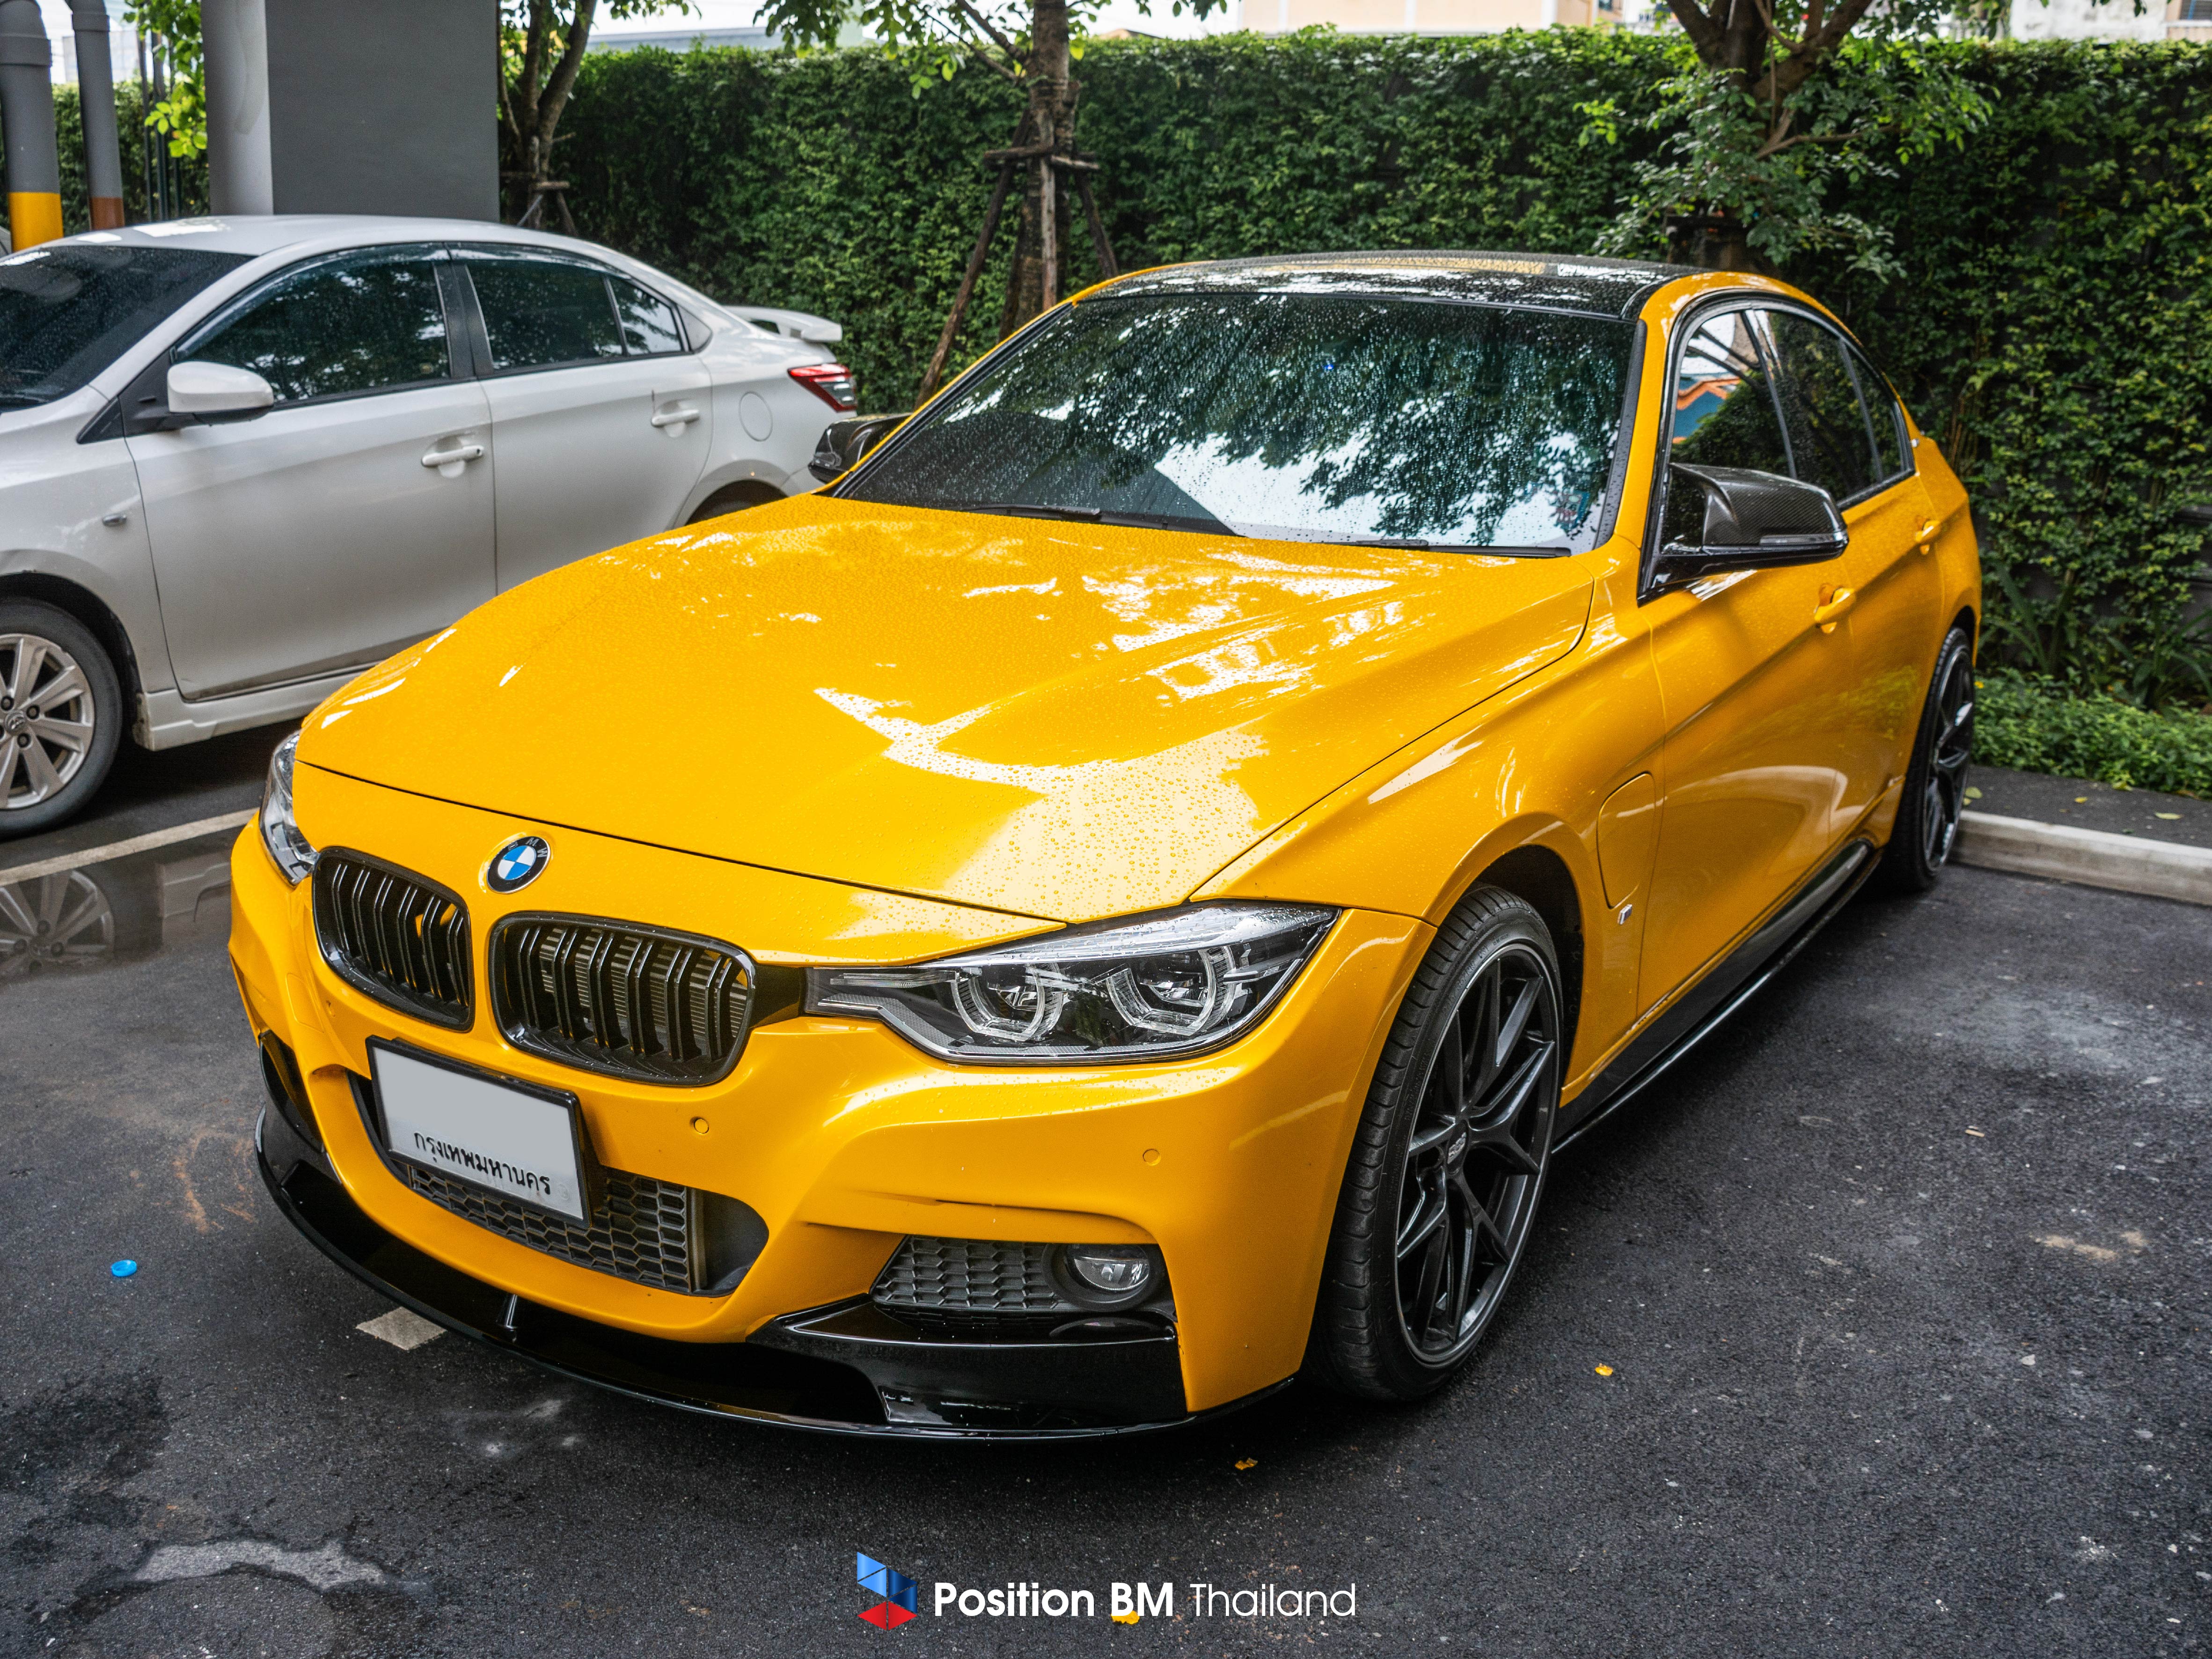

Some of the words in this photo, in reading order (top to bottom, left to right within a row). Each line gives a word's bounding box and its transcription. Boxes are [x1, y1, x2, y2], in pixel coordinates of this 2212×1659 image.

[507, 837, 548, 858] BMW
[414, 1132, 551, 1195] กรุงเทพมหานคร
